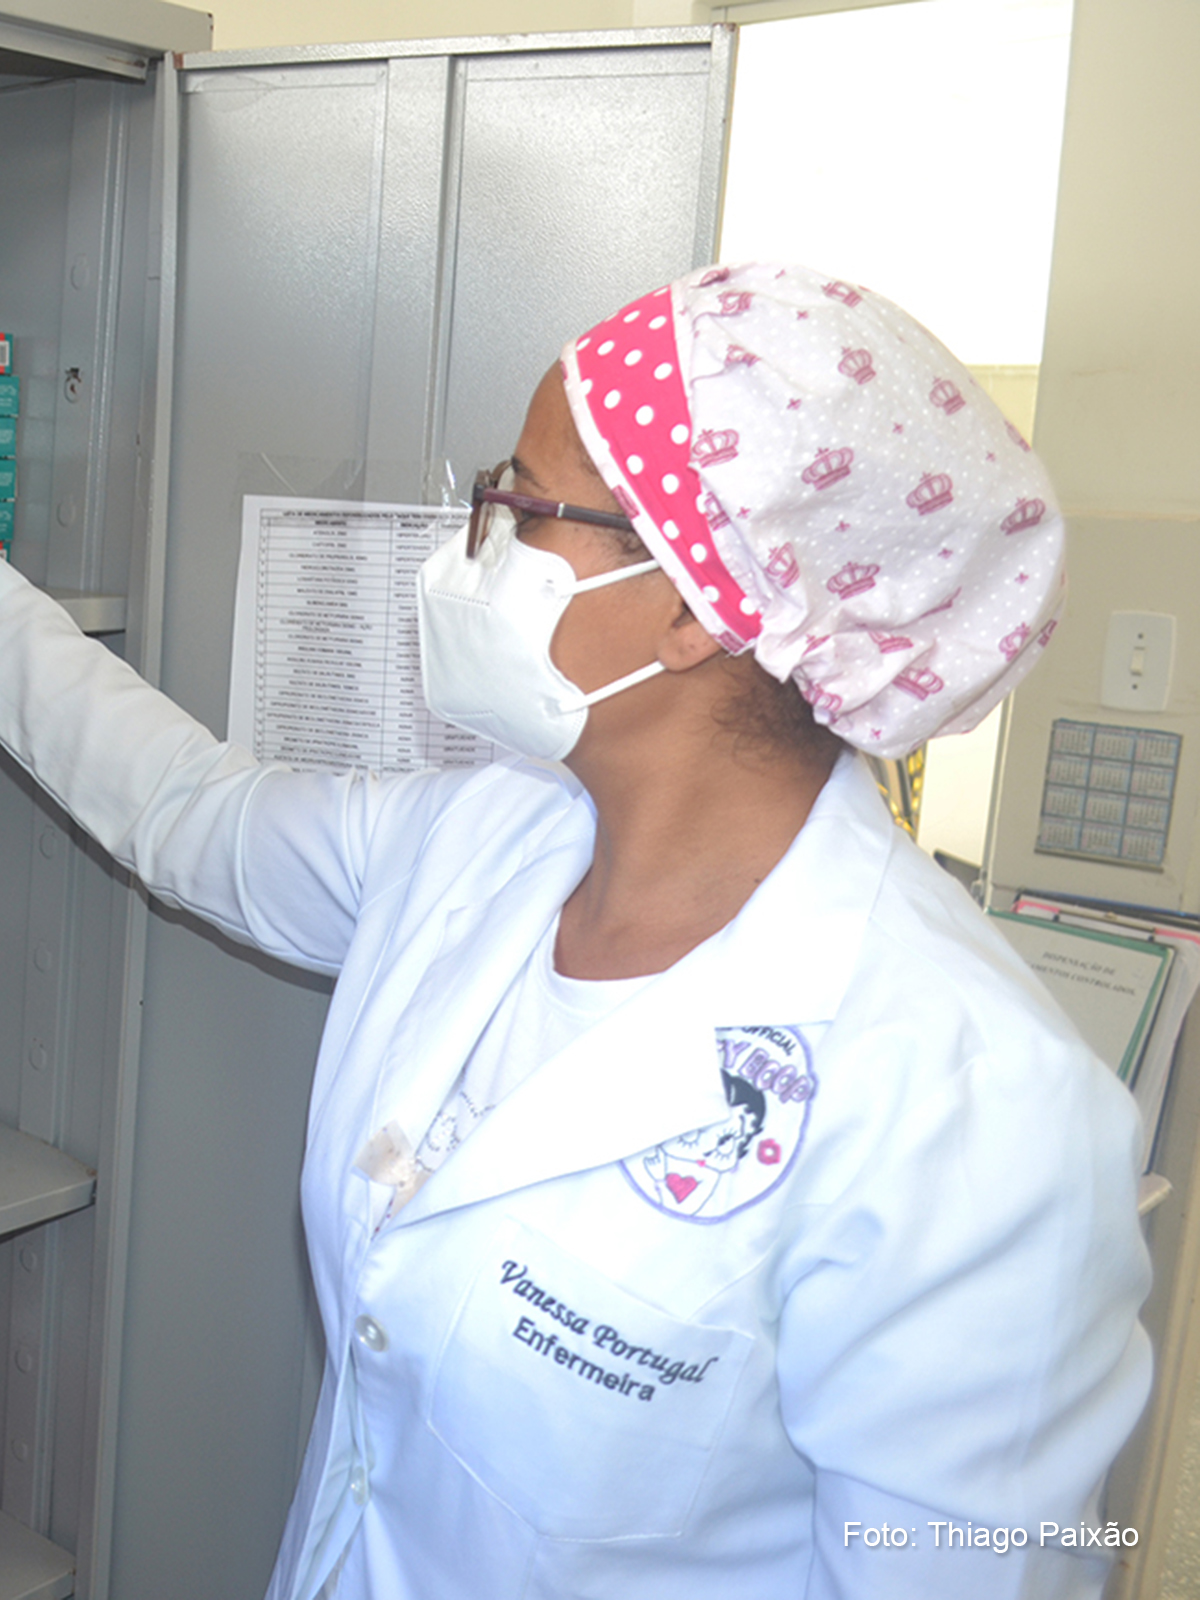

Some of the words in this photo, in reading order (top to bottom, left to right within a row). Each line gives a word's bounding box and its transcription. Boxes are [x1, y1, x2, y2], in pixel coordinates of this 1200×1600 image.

[500, 1259, 590, 1335] Vanessa
[593, 1324, 719, 1385] Portugal
[512, 1315, 656, 1402] Enfermeira
